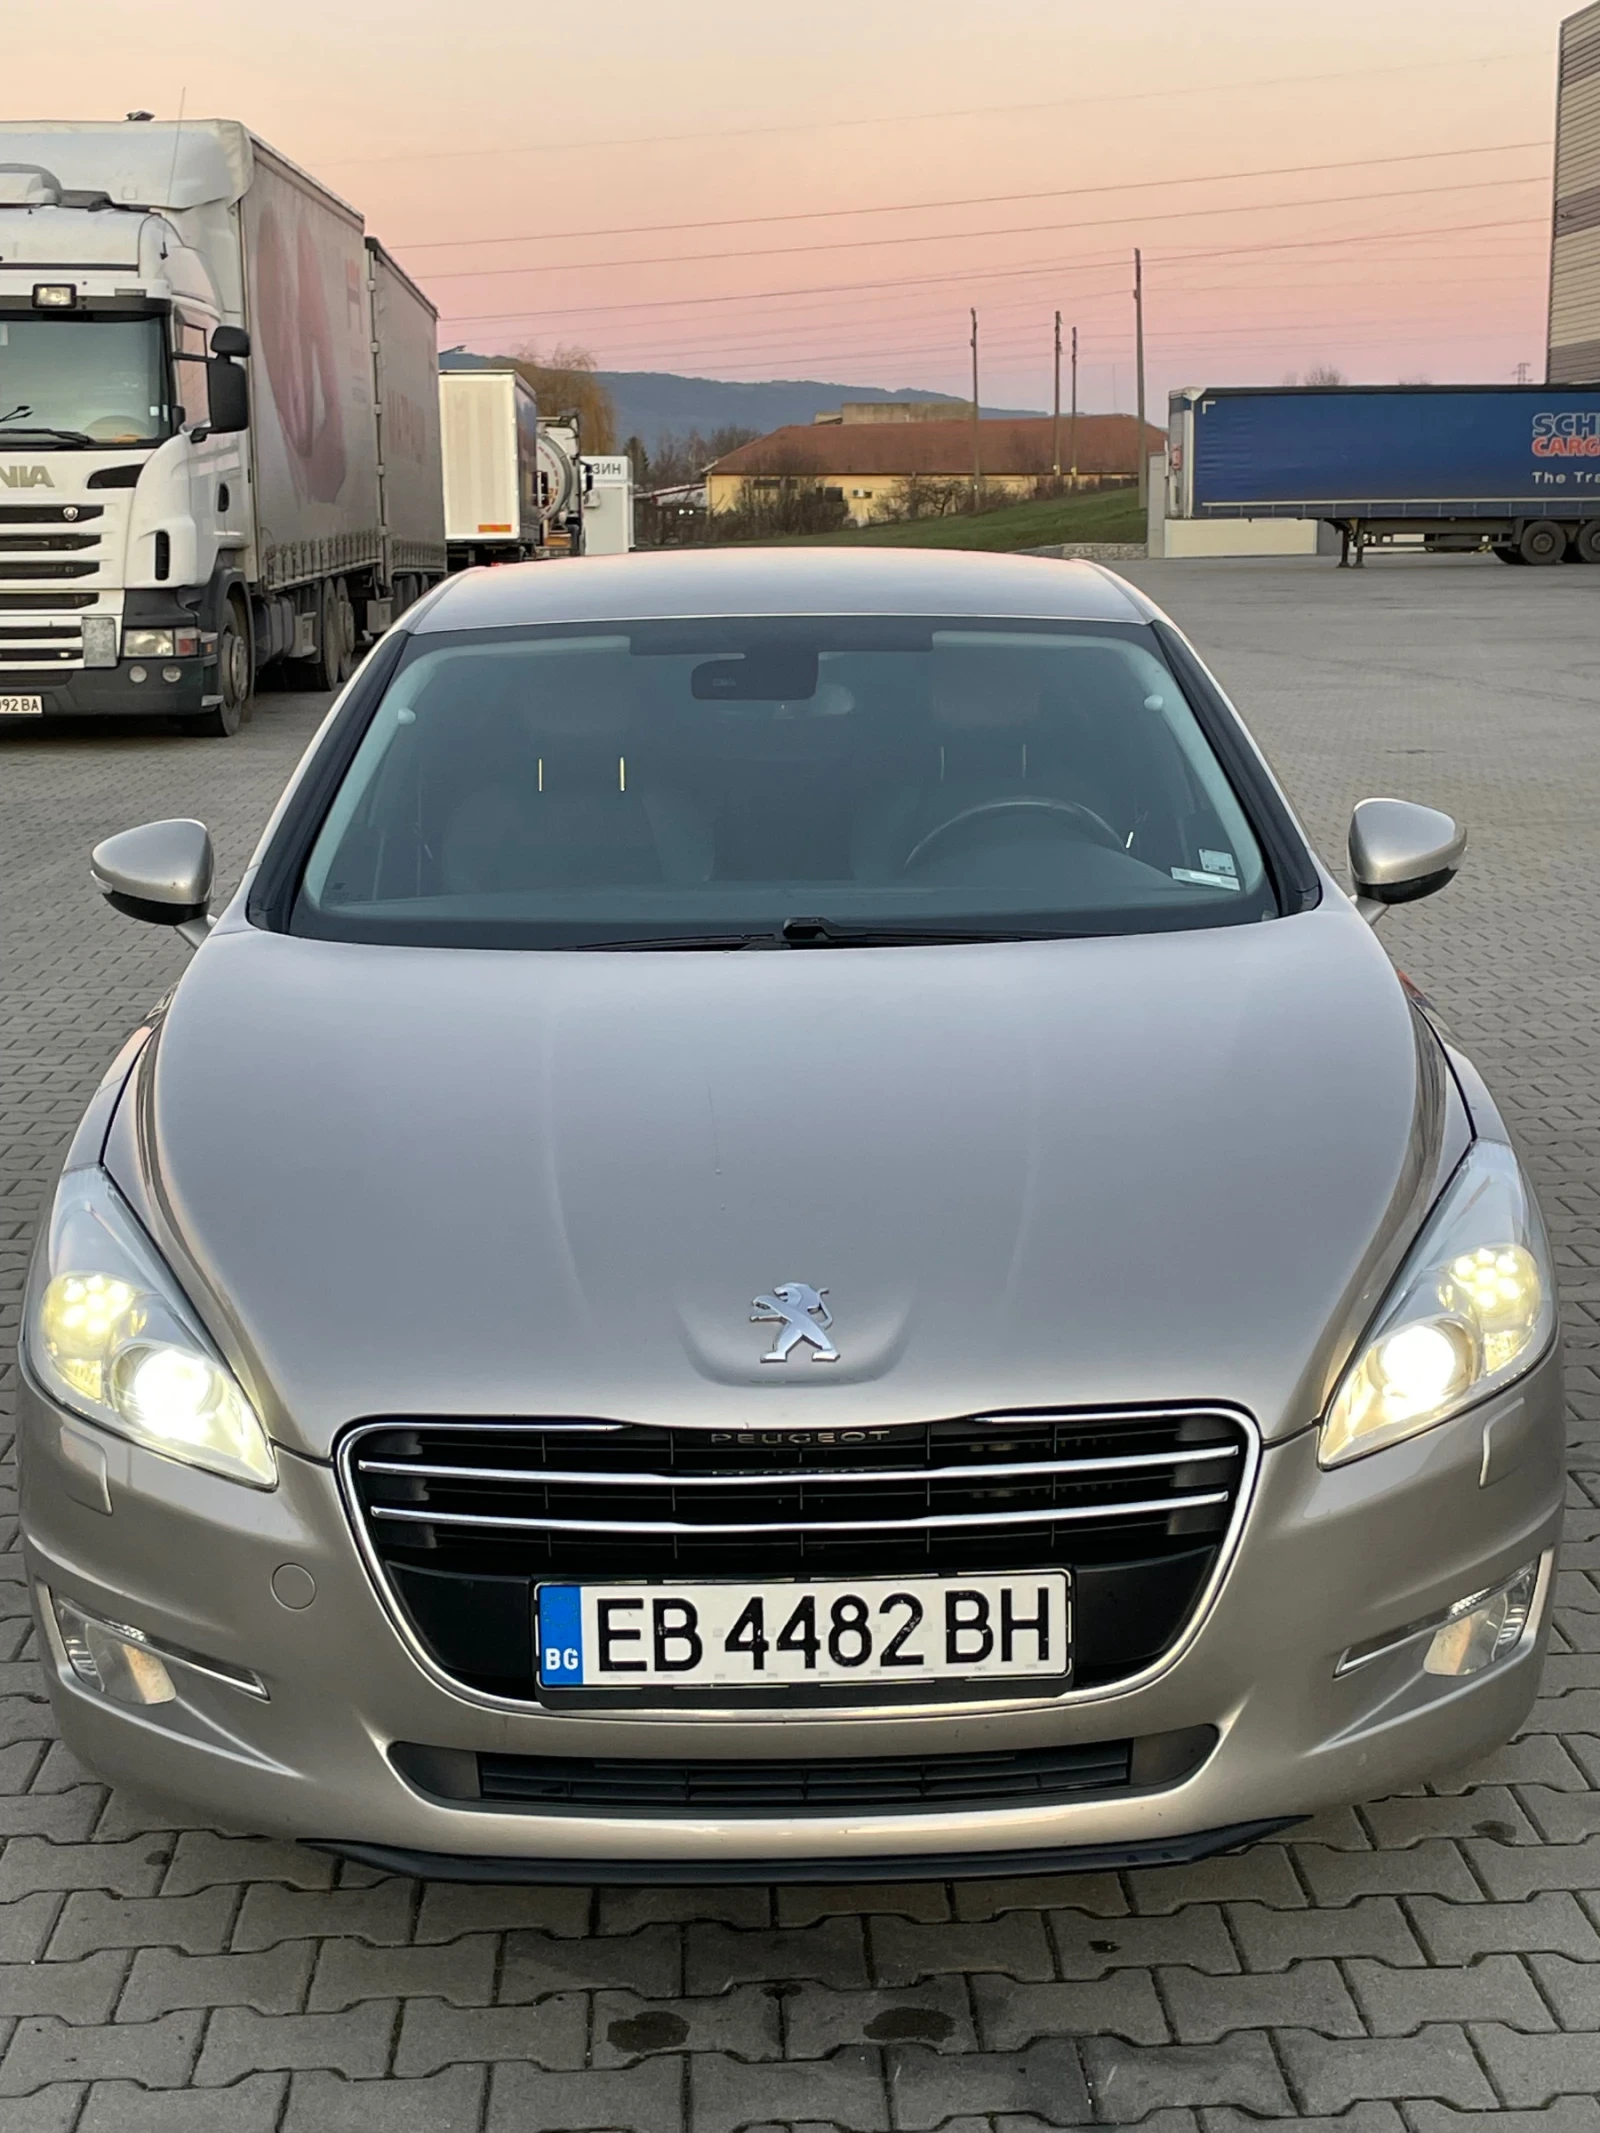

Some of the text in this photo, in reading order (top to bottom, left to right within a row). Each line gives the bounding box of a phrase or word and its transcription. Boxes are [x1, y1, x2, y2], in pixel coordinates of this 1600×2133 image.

[1532, 413, 1600, 438] SCH
[583, 463, 621, 474] ЗИН
[1532, 471, 1566, 484] The
[0, 698, 39, 711] 92 BA
[710, 1430, 890, 1445] PEUGEOT
[596, 1586, 1050, 1673] EB 4482 BH
[545, 1647, 579, 1671] BG
